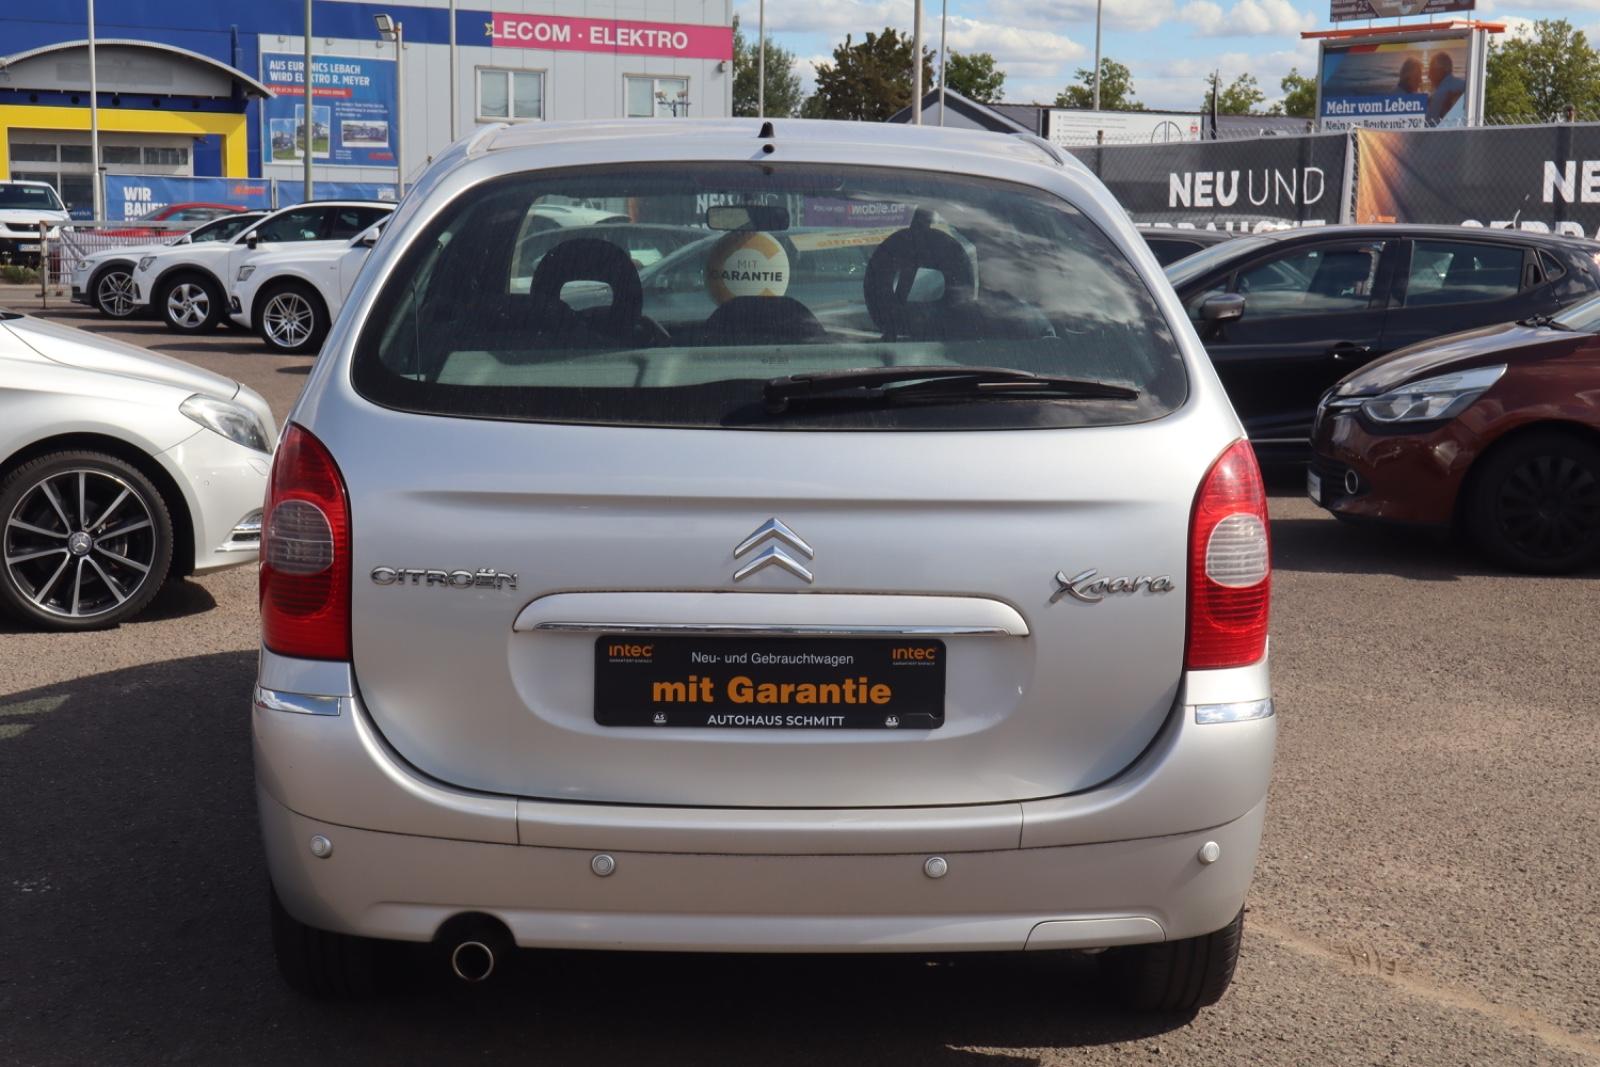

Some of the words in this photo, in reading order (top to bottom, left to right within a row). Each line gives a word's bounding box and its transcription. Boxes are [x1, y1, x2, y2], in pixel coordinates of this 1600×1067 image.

[590, 27, 688, 49] ELEKTRO
[270, 60, 286, 71] AUS
[288, 61, 328, 73] EURNICS
[330, 64, 361, 74] LEBACH
[270, 71, 293, 82] WIRD
[295, 73, 331, 84] ELKTRO
[332, 75, 341, 84] R.
[342, 76, 370, 86] MEYER
[1326, 99, 1356, 114] Mehr
[1358, 102, 1383, 112] vom
[1385, 98, 1424, 112] Leben.
[123, 186, 152, 201] WIR
[1169, 170, 1240, 207] NEU
[1249, 167, 1324, 206] UND
[124, 202, 168, 216] BAU
[737, 259, 757, 269] MIT
[371, 566, 518, 590] CITROËN
[609, 644, 653, 657] intec
[892, 647, 935, 660] intec
[691, 652, 721, 663] Neu-
[724, 653, 748, 664] und
[751, 652, 854, 667] Gebrauchtwagen
[653, 675, 714, 703] mit
[727, 675, 892, 704] Garantie
[707, 715, 782, 726] AUTOHAUS
[786, 716, 845, 726] SCHMITT
